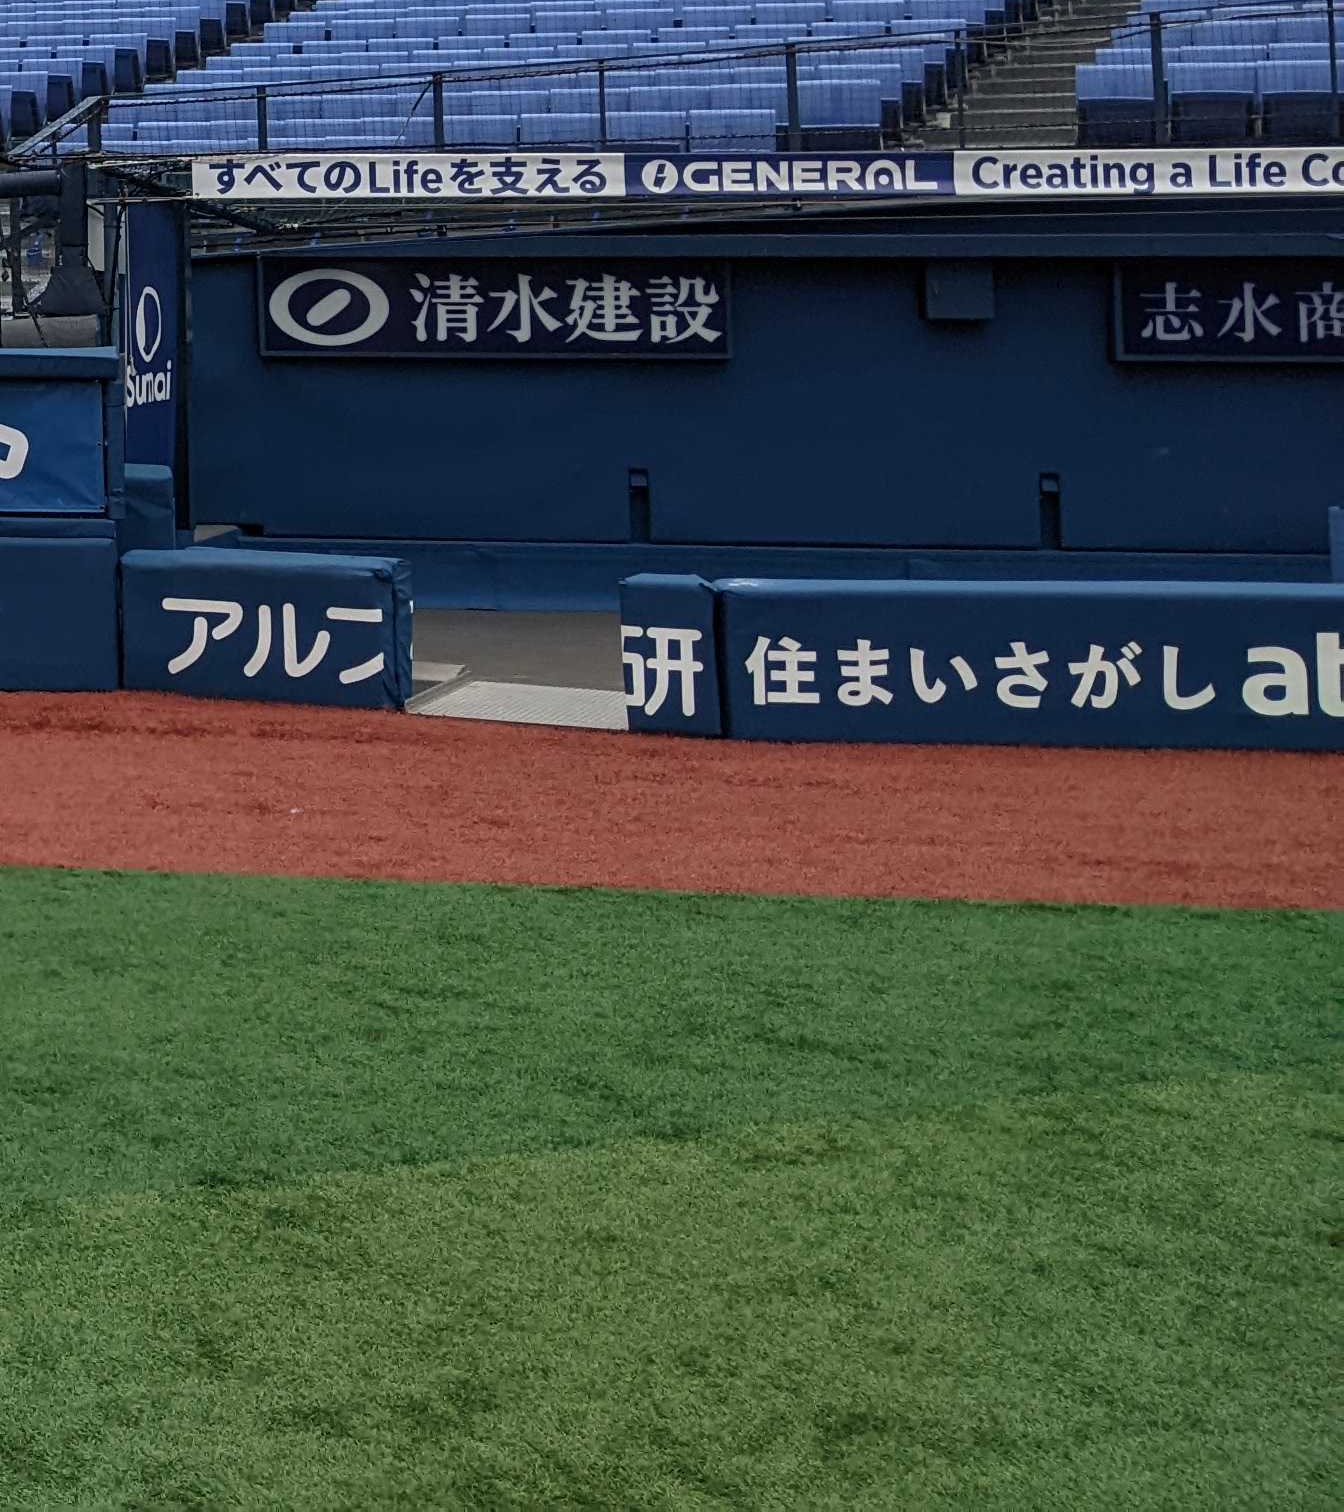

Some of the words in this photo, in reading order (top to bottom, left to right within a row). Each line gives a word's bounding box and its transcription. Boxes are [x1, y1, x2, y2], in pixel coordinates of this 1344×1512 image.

[209, 159, 607, 195] すべてのLifeを支える
[683, 159, 939, 192] GENERAL
[971, 155, 1155, 195] Creating
[1169, 161, 1193, 188] a
[1208, 153, 1287, 187] Life
[410, 272, 723, 345] 清水建設
[1139, 281, 1344, 343] 志水商
[745, 634, 1216, 711] 住まいさがし
